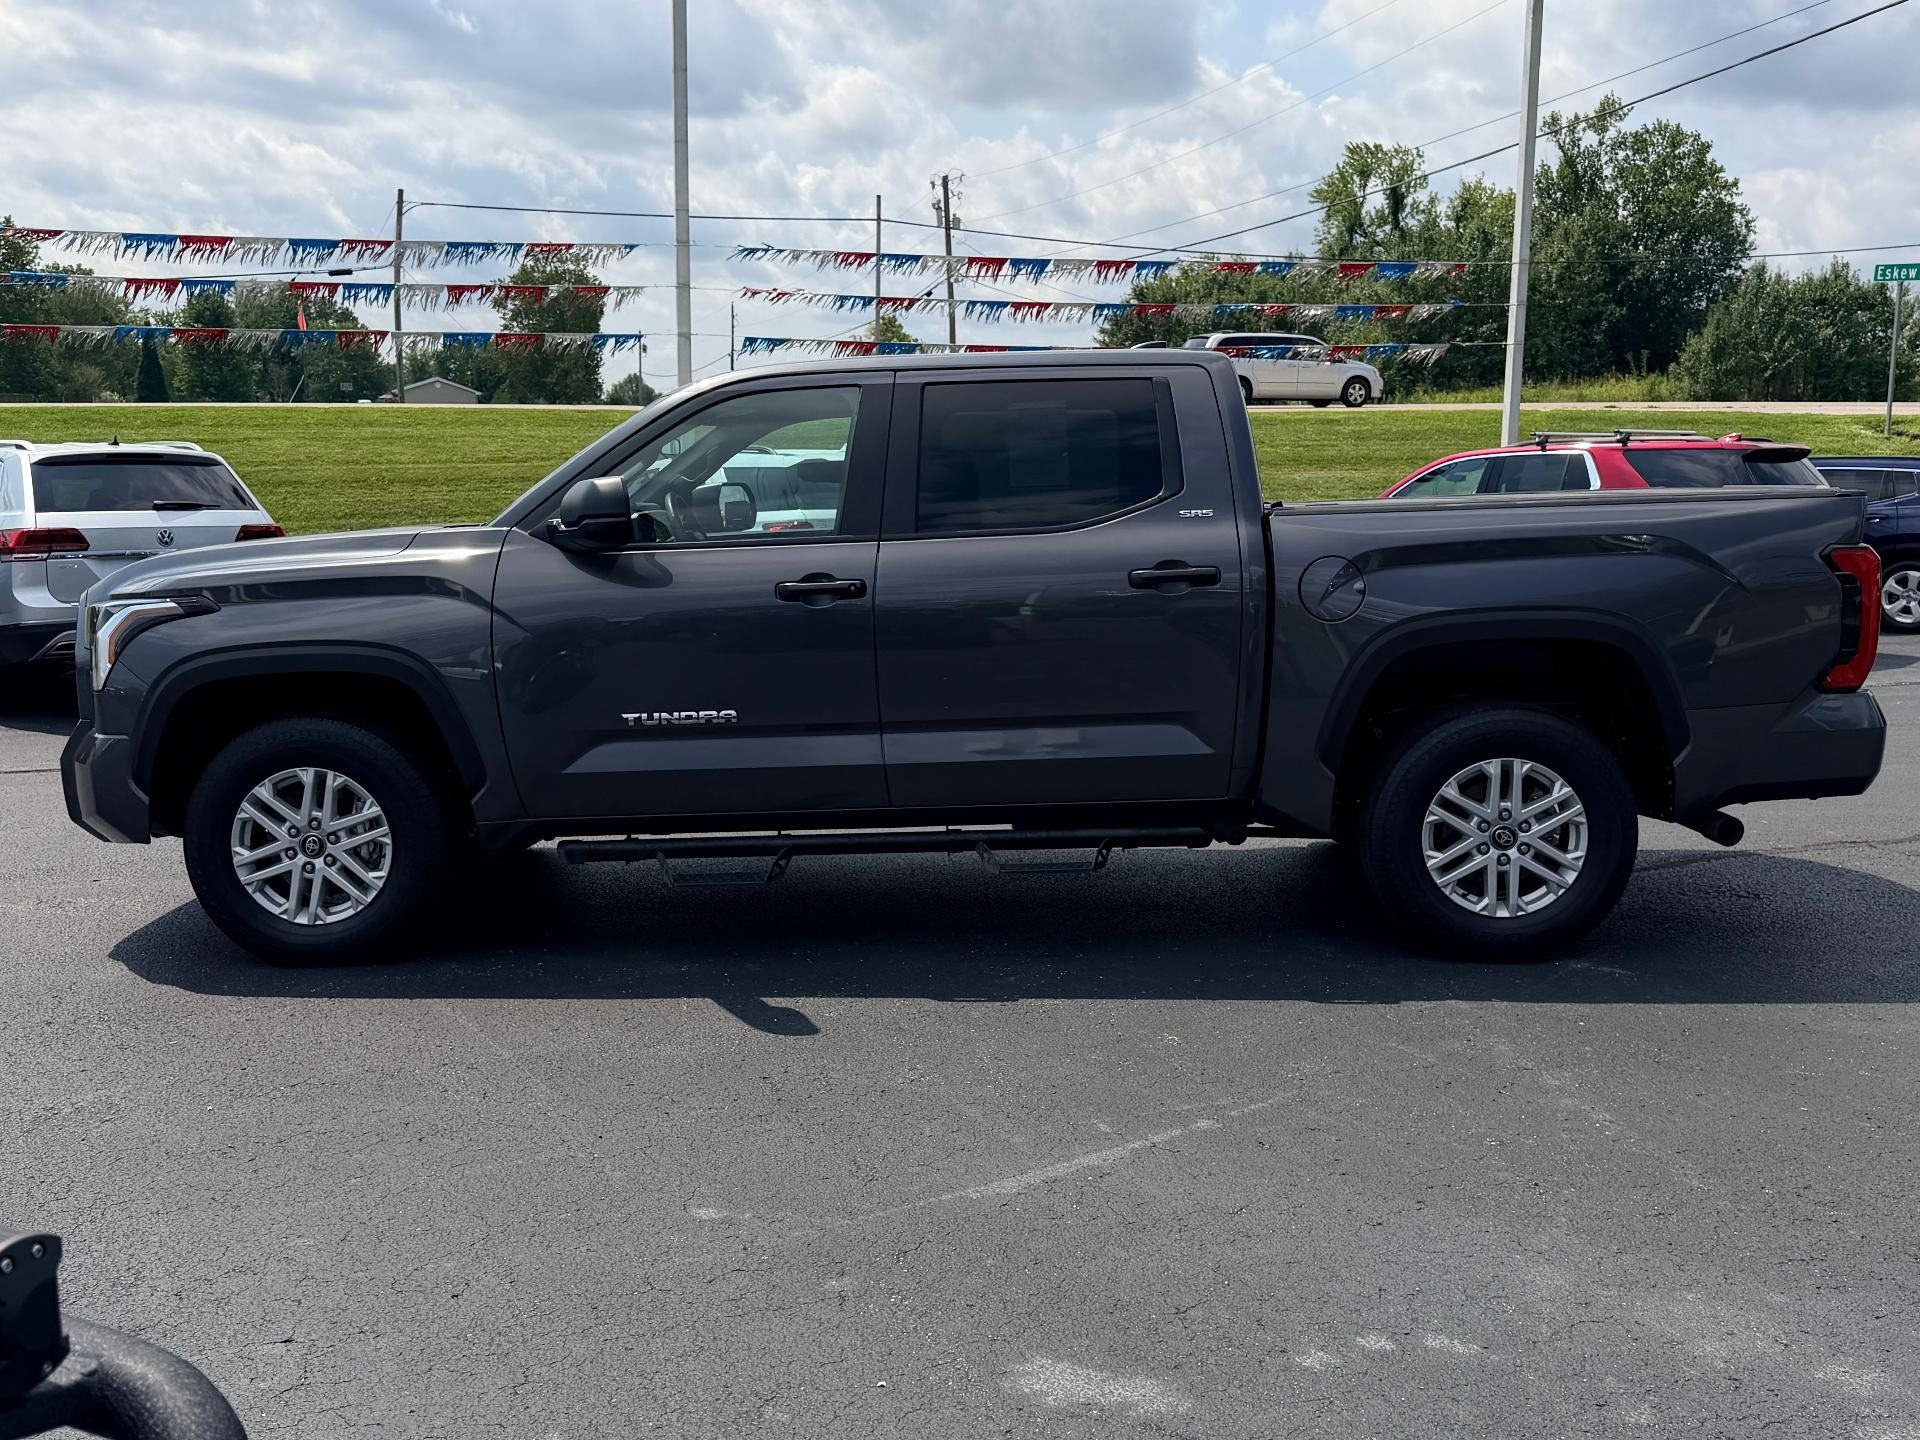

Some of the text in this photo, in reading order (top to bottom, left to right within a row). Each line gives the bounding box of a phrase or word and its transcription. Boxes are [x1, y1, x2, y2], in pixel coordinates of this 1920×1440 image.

[1877, 266, 1918, 280] Eskew
[1178, 509, 1214, 518] SR5
[621, 709, 738, 727] TUNDRA
